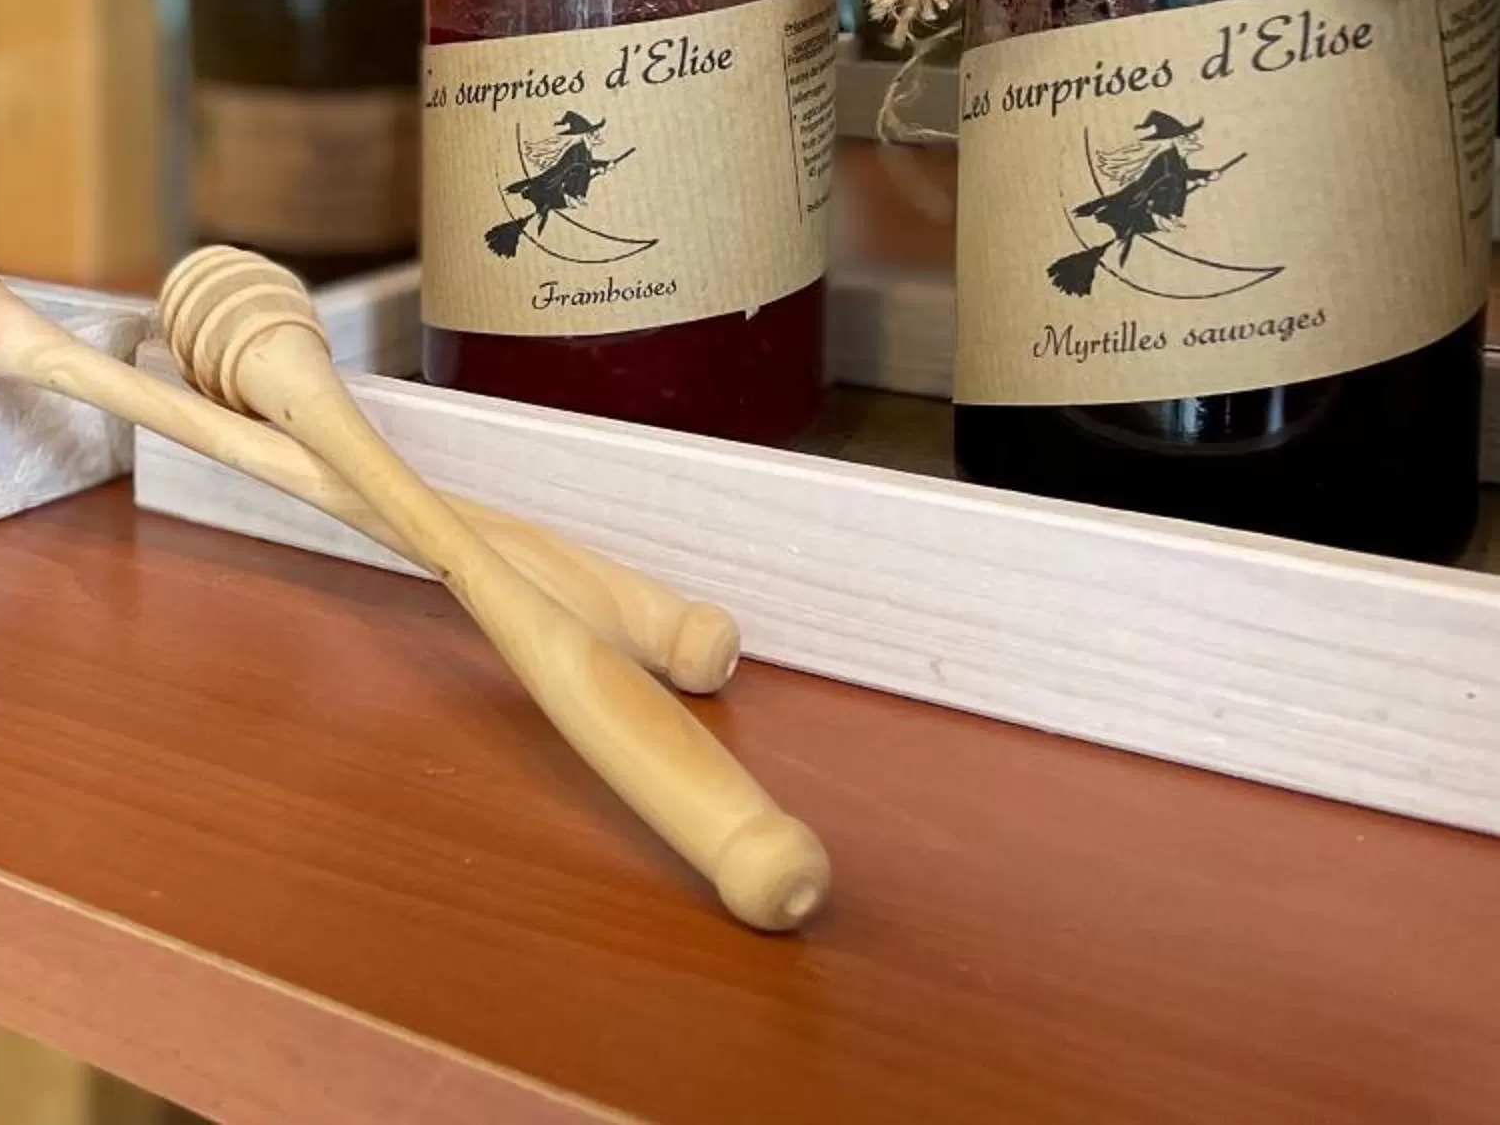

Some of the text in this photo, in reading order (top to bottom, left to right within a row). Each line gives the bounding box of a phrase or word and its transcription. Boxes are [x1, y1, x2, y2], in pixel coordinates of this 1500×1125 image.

[455, 69, 586, 111] surprises
[605, 35, 734, 90] d'Elise
[962, 9, 1374, 123] Les surprises d'Elise
[531, 276, 678, 310] Framboises
[1032, 308, 1328, 364] Myrtilles sauvages
